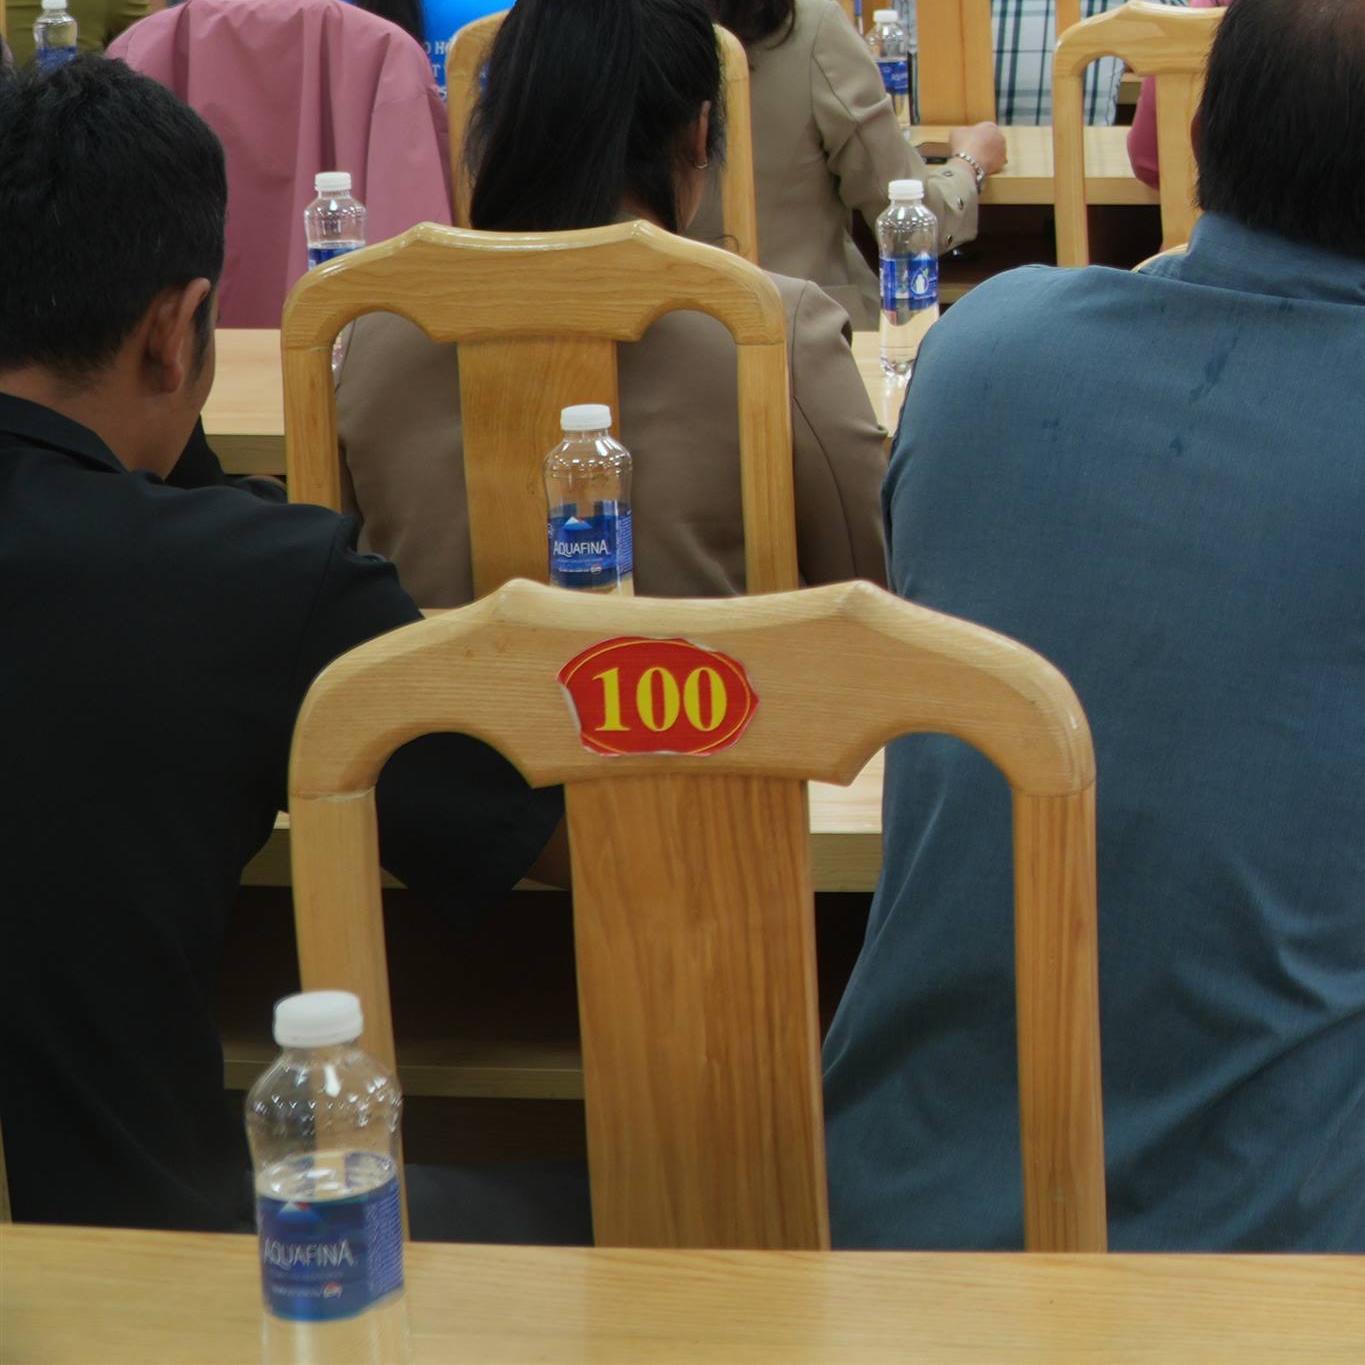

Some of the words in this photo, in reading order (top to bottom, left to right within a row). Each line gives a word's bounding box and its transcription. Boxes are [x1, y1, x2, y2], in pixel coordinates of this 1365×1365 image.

[553, 539, 609, 558] AQUAFINA
[593, 665, 727, 733] 100
[263, 1238, 353, 1271] AQUAFINA
